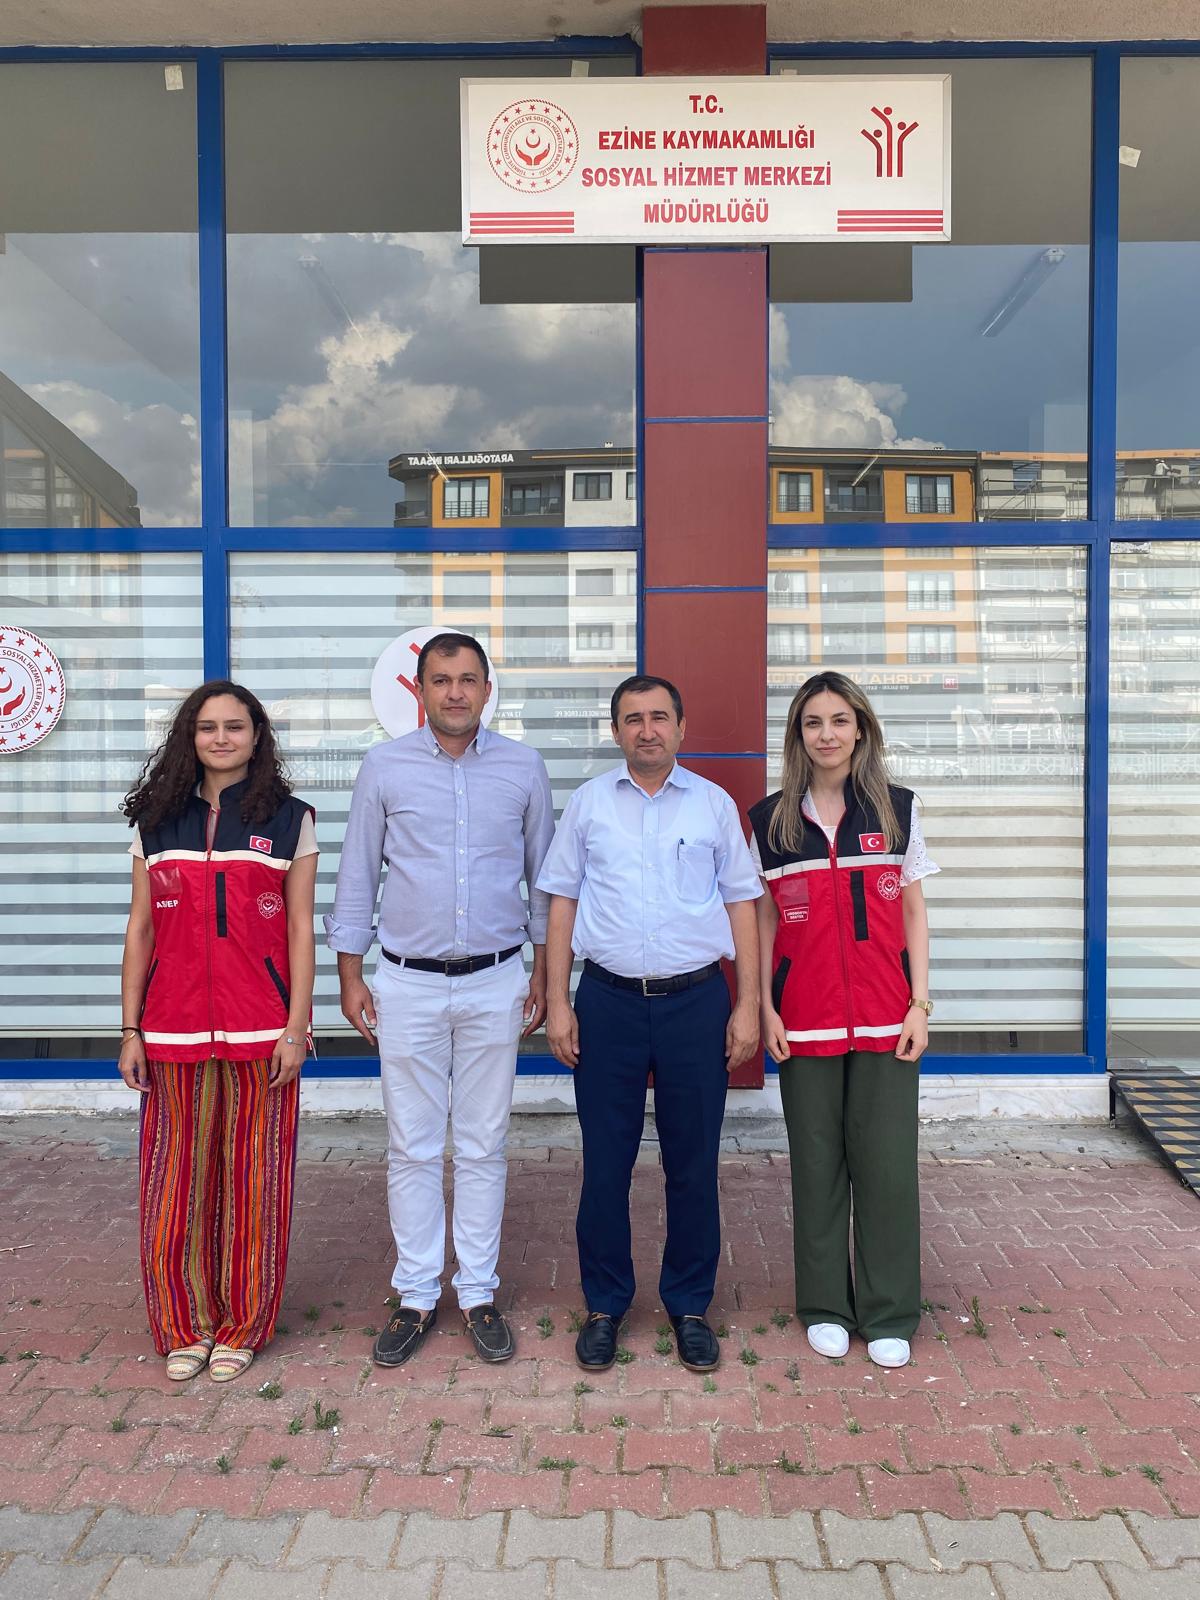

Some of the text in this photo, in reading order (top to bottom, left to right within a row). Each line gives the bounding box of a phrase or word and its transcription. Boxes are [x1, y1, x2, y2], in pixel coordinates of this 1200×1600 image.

[689, 95, 723, 114] T.C.
[598, 124, 815, 149] EZİNE KAYMAKAMLIĞI
[582, 161, 832, 187] SOSYAL HİZMET MERKEZİ
[644, 198, 769, 223] MÜDÜRLÜĞÜ
[2, 650, 26, 664] SOSYAL
[27, 662, 42, 702] HİZMETLER
